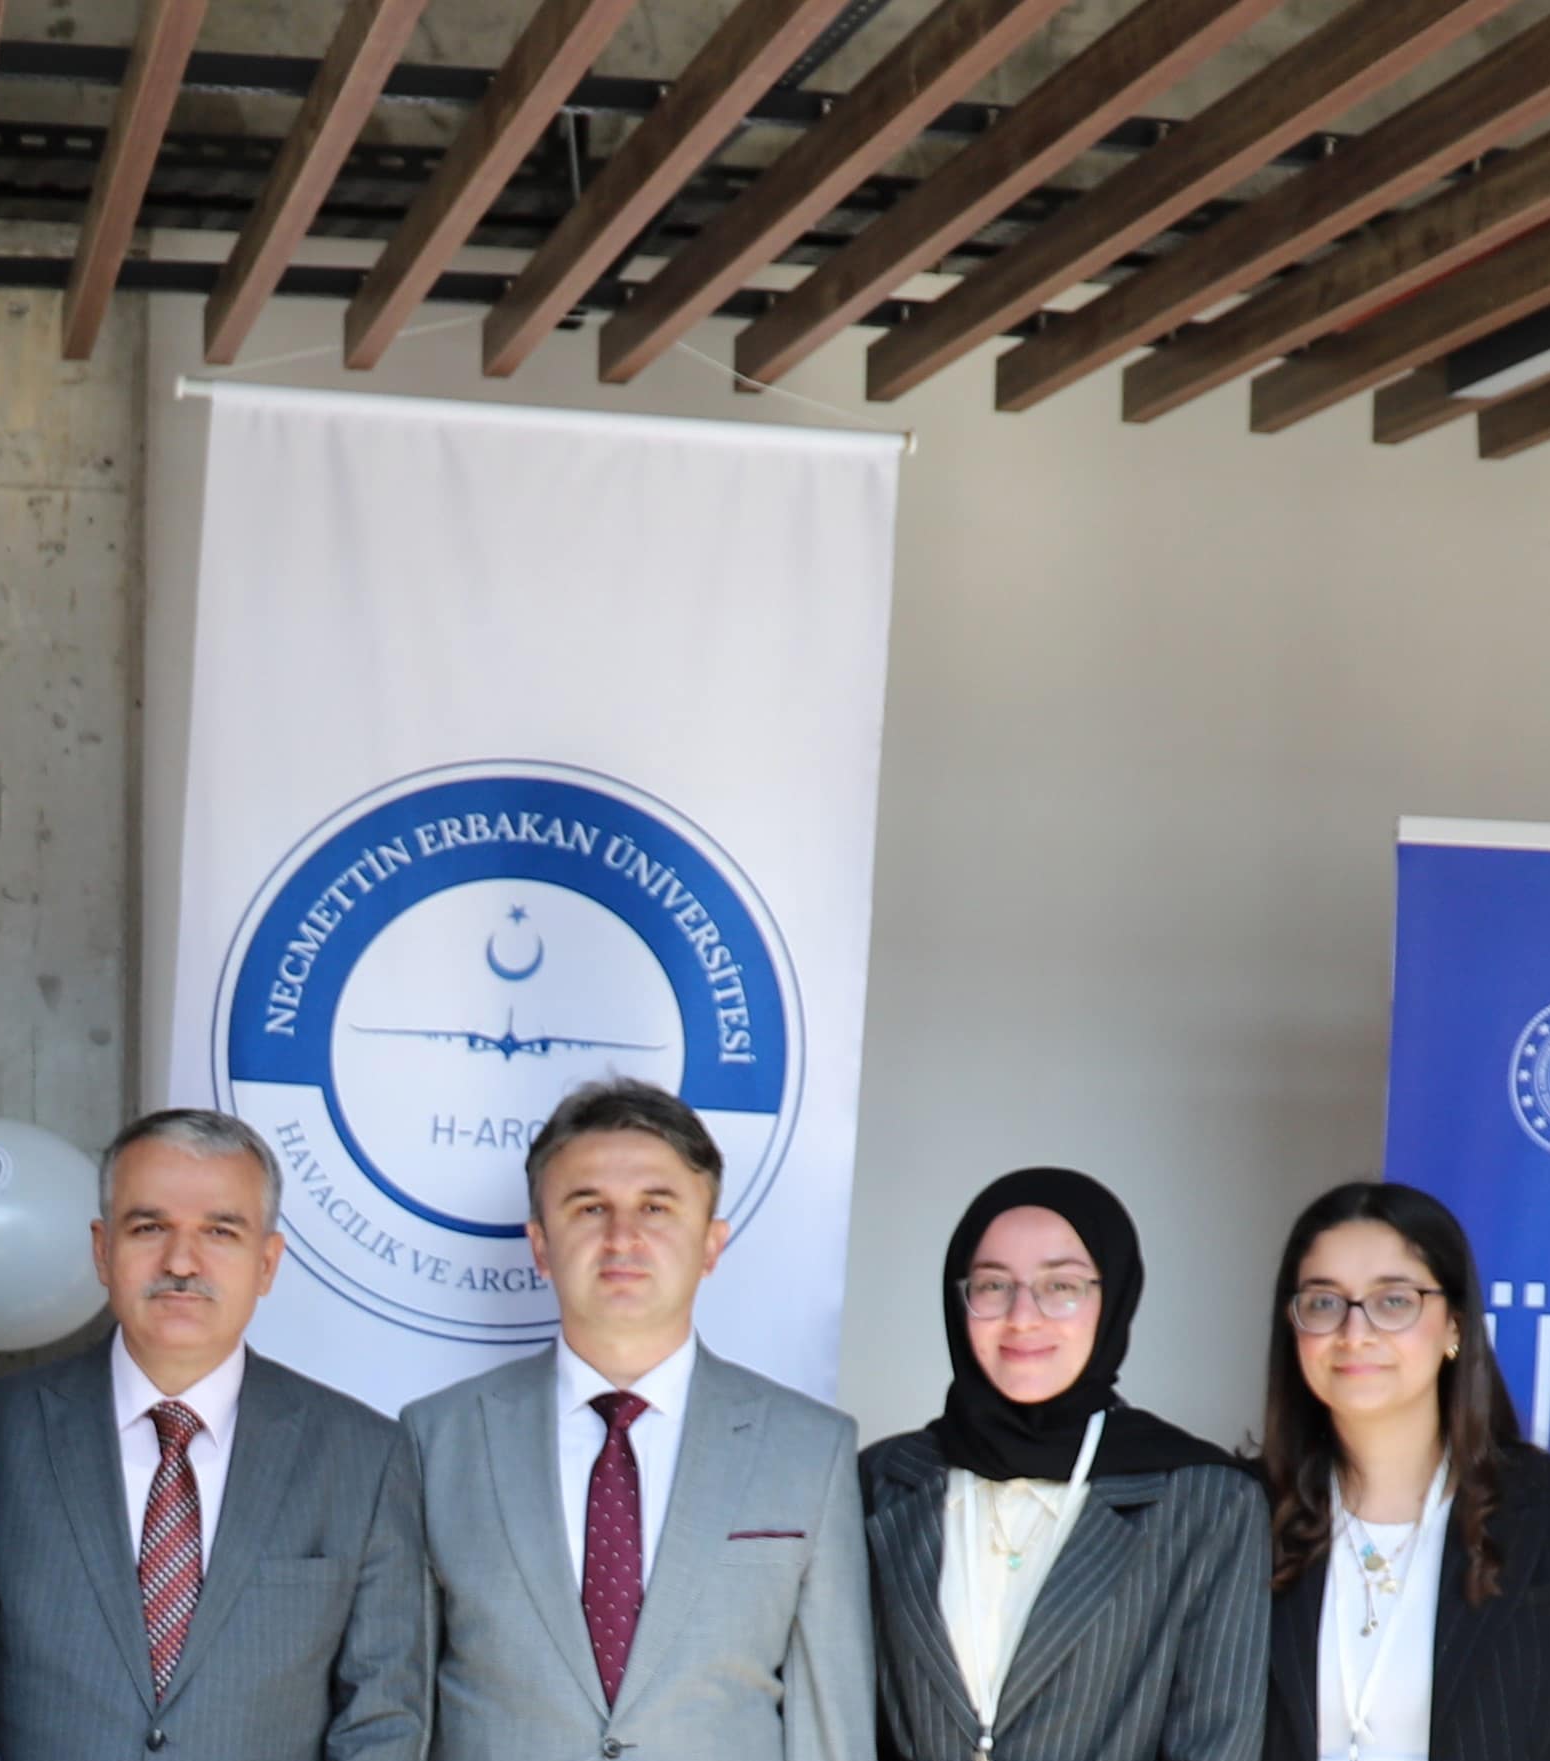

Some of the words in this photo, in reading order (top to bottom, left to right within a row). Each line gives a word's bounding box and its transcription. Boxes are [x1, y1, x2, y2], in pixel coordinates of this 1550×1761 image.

[265, 835, 413, 1036] NECMETTİN
[414, 811, 601, 856] ERBAKAN
[603, 833, 757, 1064] ÜNİVERSİTESİ
[276, 1120, 407, 1266] HAVACILIK
[410, 1249, 452, 1284] VE
[455, 1266, 549, 1293] ARGE
[431, 1114, 548, 1149] H-AR
